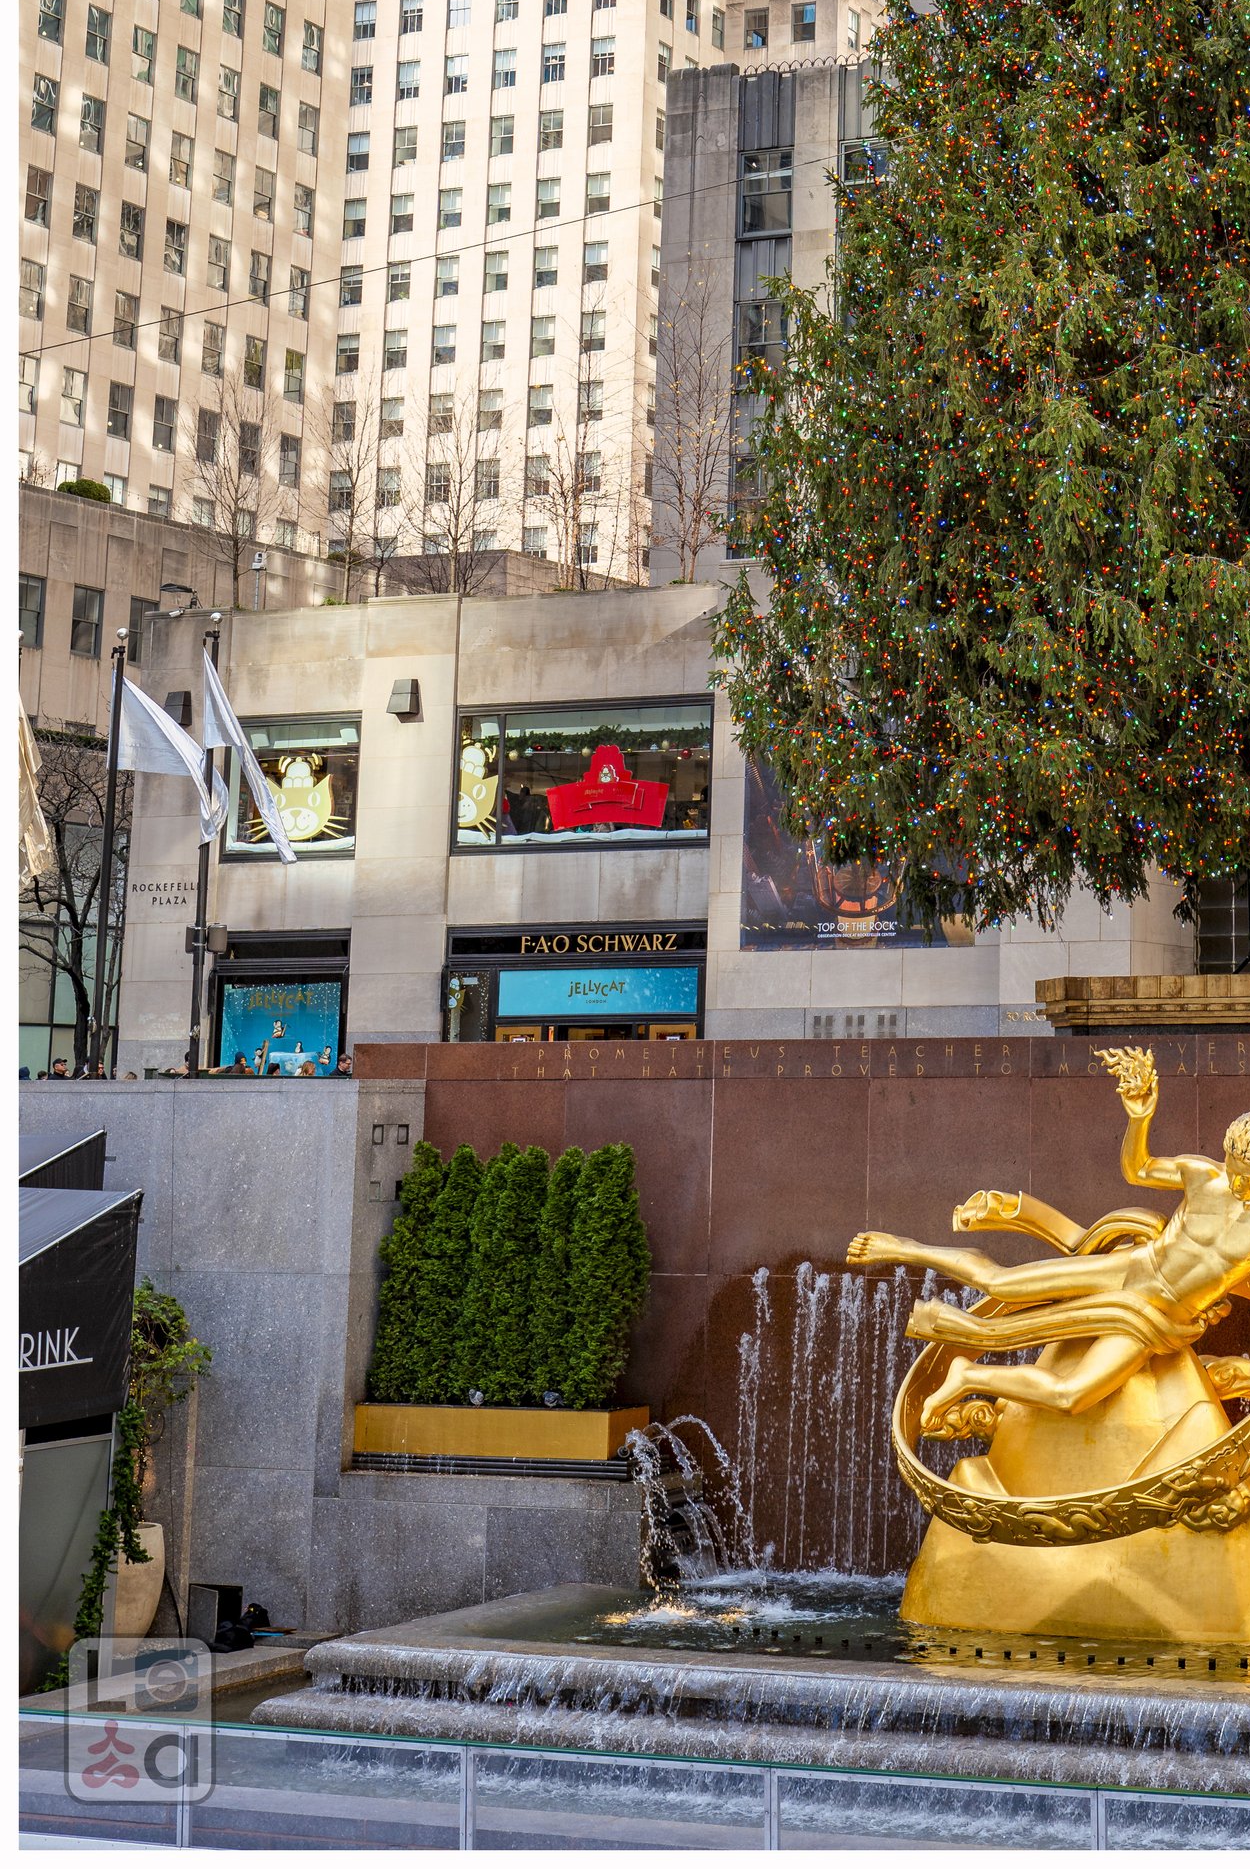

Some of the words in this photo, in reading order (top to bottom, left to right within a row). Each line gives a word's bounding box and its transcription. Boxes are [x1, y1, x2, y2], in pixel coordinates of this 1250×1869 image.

[131, 882, 208, 893] ROCKEFELL
[152, 896, 187, 905] PLAZA
[817, 923, 836, 932] TOP
[837, 922, 849, 932] OF
[851, 921, 867, 931] THE
[576, 933, 678, 953] SCHWARZ
[538, 1046, 785, 1060] PROMETHEUS
[833, 1044, 1010, 1059] TEACHER
[1062, 1043, 1098, 1056] IN
[511, 1066, 597, 1078] THAT
[642, 1064, 731, 1078] HATH
[777, 1063, 924, 1077] PROVED
[974, 1063, 1012, 1076] TO
[1058, 1060, 1246, 1075] MOALS
[20, 1326, 80, 1369] RINK
